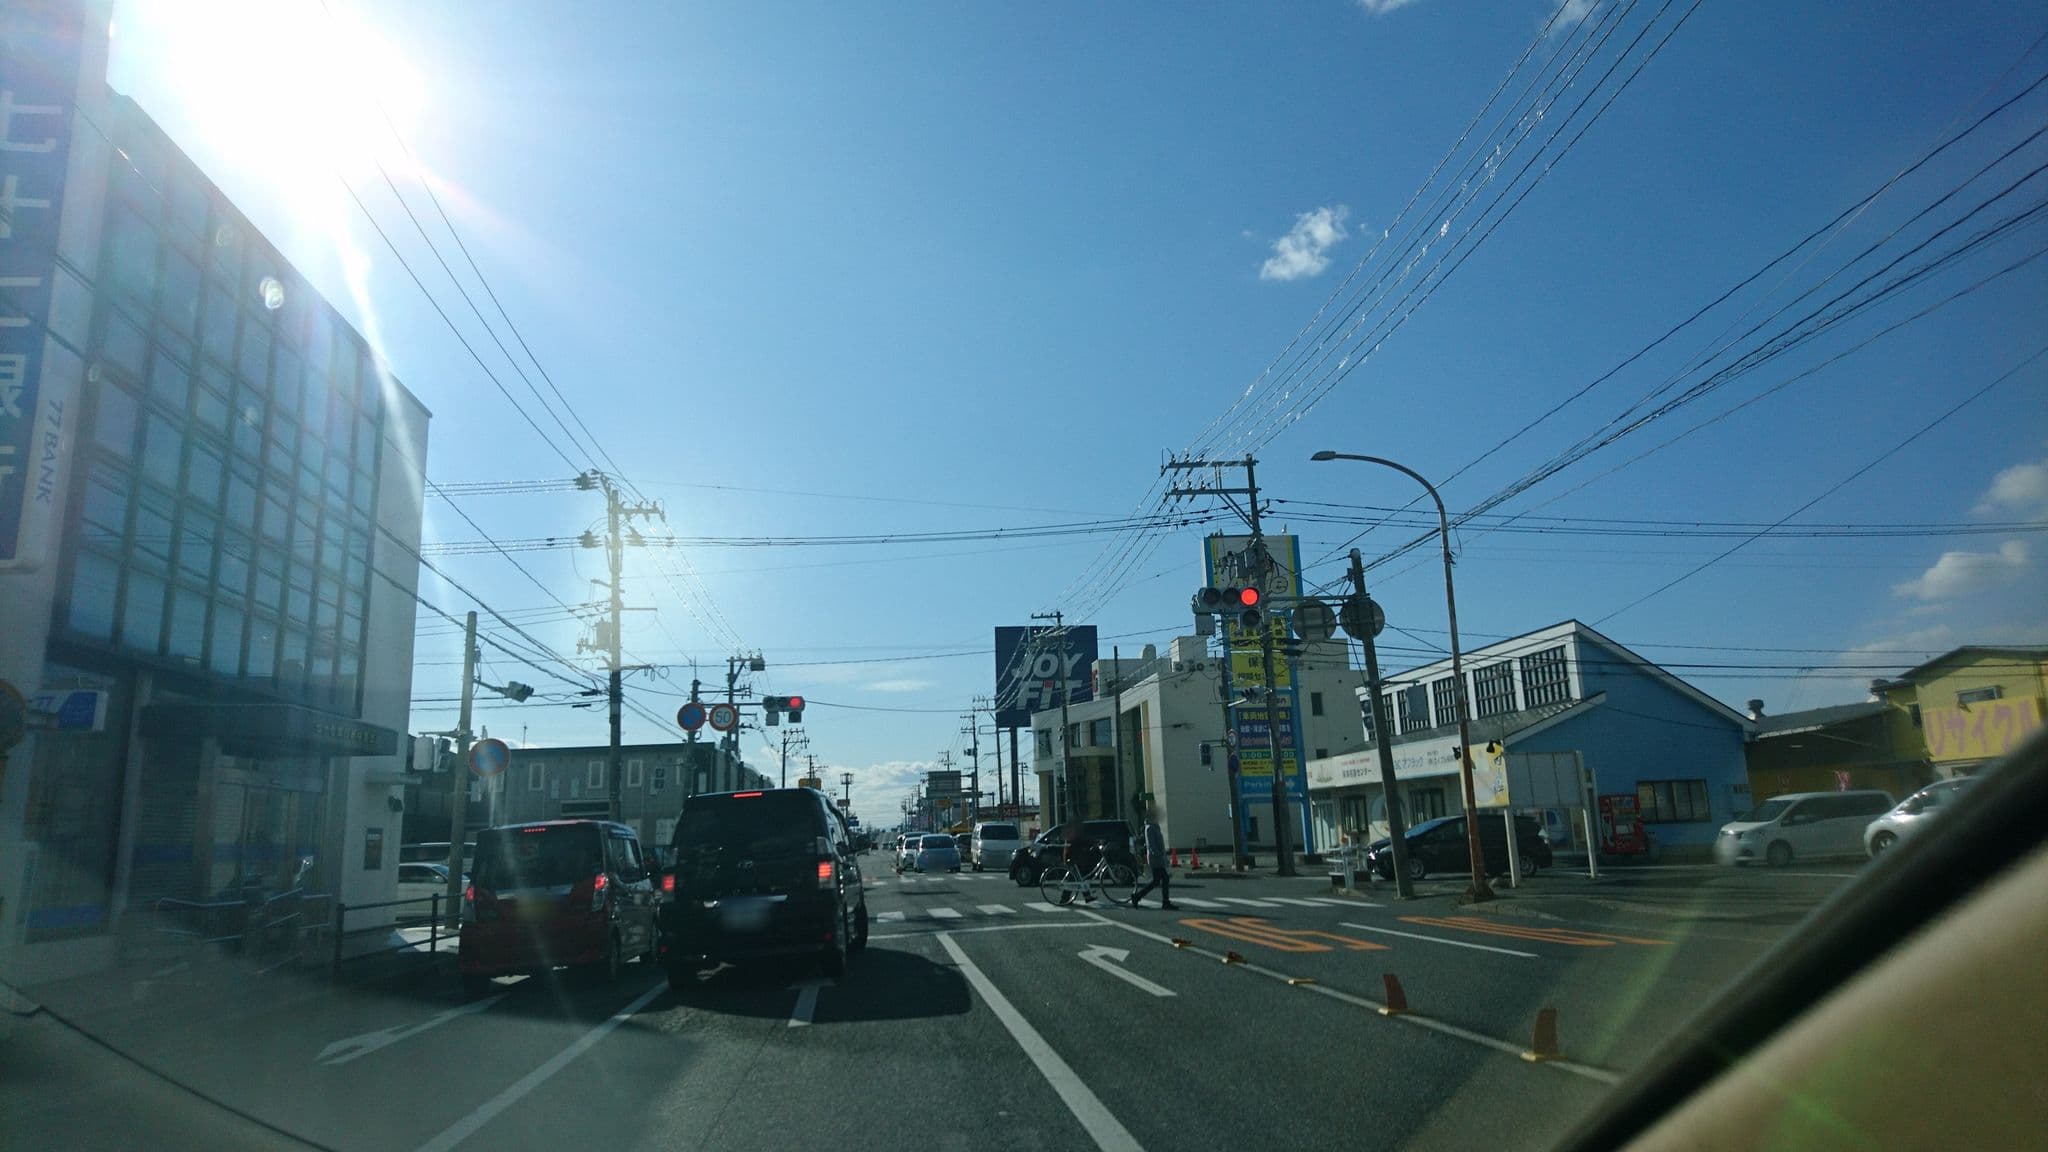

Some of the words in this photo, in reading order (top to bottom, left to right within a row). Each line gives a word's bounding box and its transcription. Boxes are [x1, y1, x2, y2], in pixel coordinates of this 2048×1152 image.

[48, 399, 64, 430] 77
[36, 431, 59, 505] BANK
[1011, 652, 1084, 679] JOY
